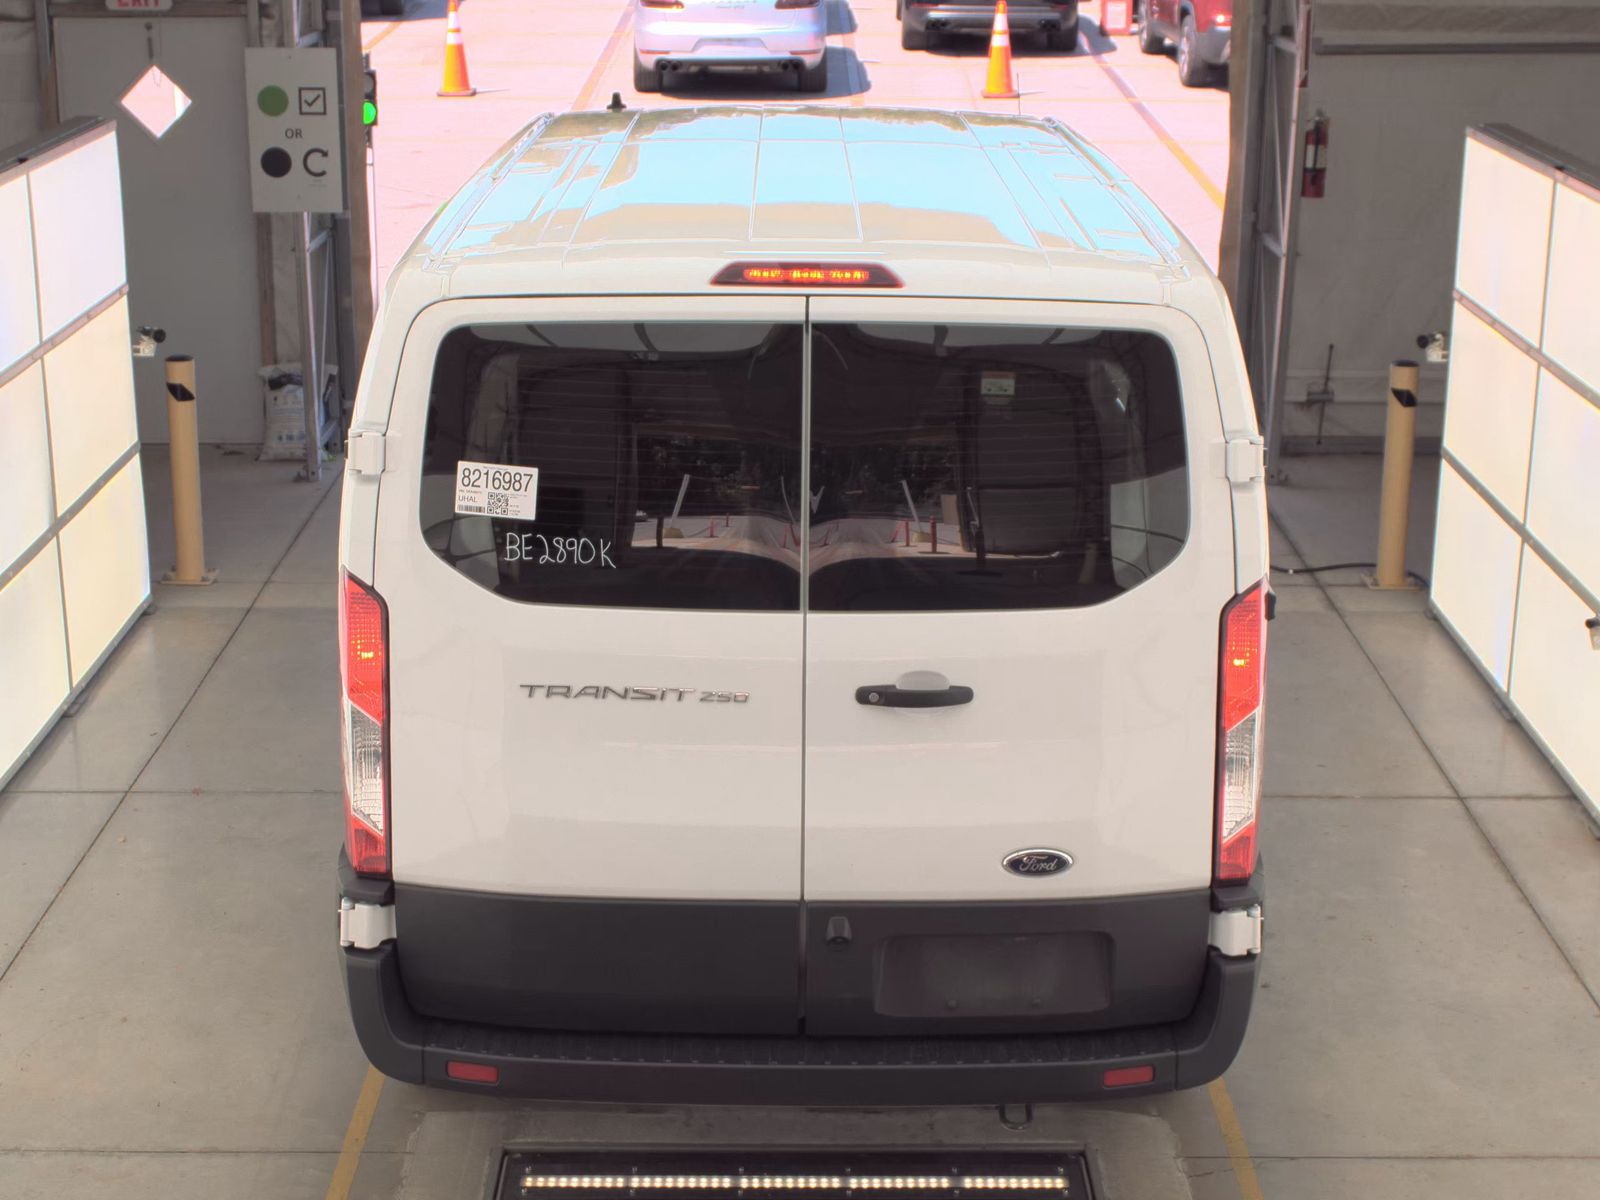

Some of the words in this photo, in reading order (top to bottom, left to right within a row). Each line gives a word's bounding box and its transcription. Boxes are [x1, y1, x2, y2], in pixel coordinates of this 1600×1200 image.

[285, 128, 303, 139] OR
[461, 467, 534, 492] 8216987
[519, 684, 696, 702] TRANSIT
[699, 690, 749, 703] 250
[1018, 855, 1059, 872] Ford
